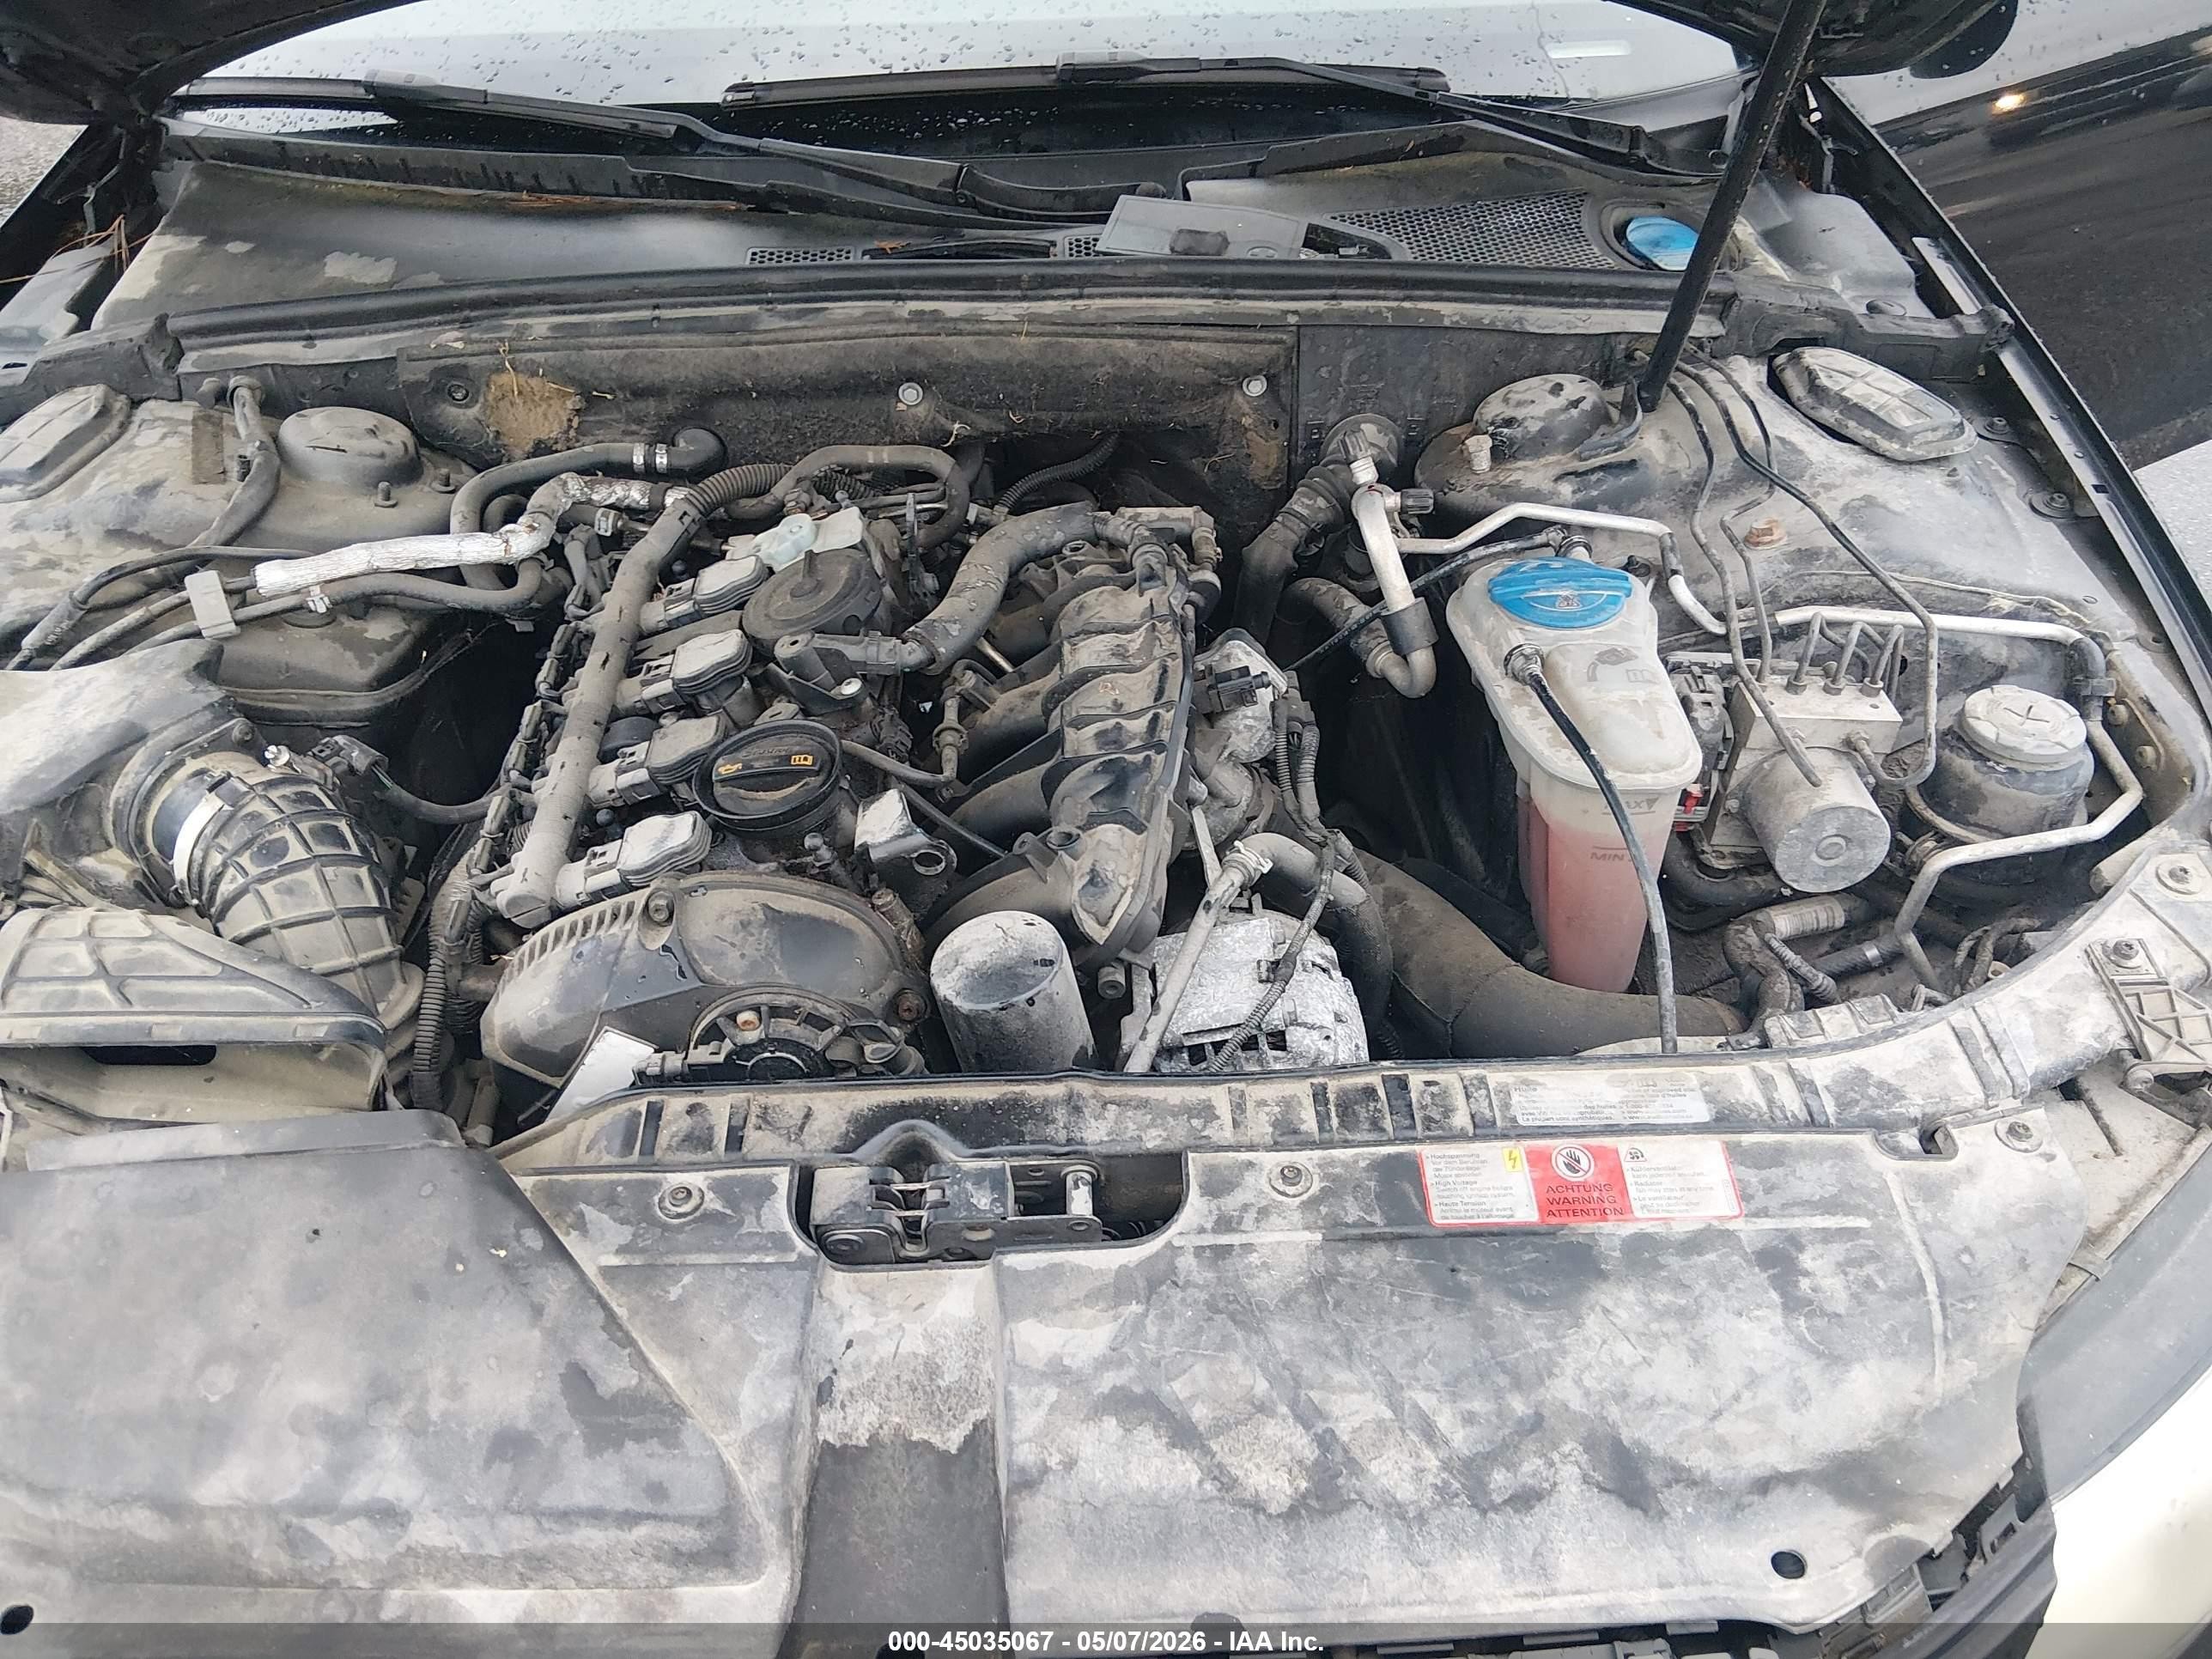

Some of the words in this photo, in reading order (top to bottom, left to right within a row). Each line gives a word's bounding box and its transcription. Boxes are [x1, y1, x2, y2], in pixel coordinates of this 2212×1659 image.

[1590, 852, 1625, 861] MIN
[1546, 1183, 1613, 1194] ACHTUNG
[1547, 1195, 1617, 1206] WARNING
[1547, 1206, 1624, 1218] ATTENTION
